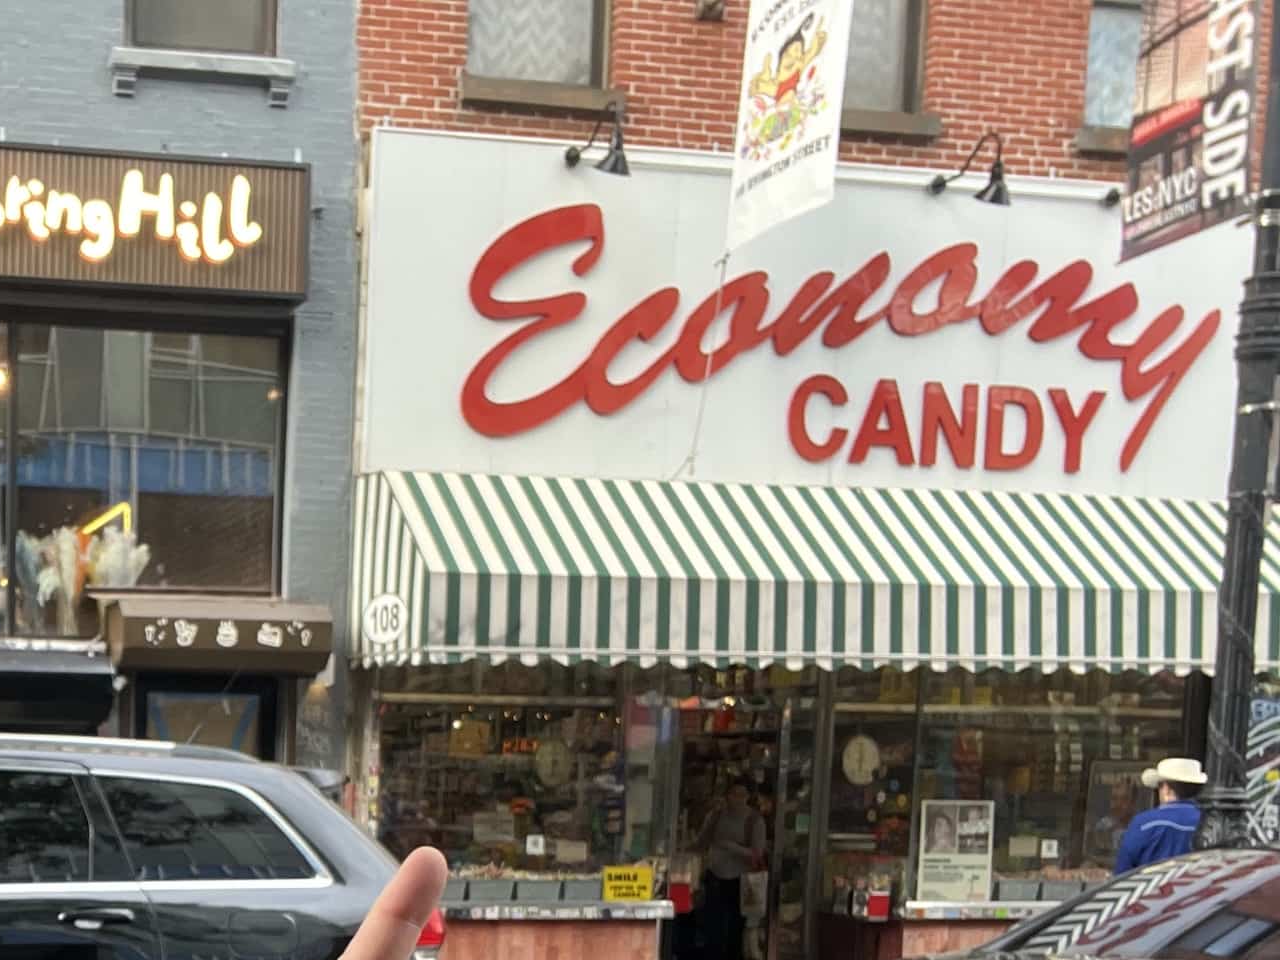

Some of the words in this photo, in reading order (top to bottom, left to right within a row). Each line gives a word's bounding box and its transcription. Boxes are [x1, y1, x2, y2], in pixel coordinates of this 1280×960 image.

[1202, 89, 1250, 208] SIDE
[460, 203, 1221, 473] Economy
[788, 374, 1106, 474] CANDY
[370, 604, 400, 635] 108
